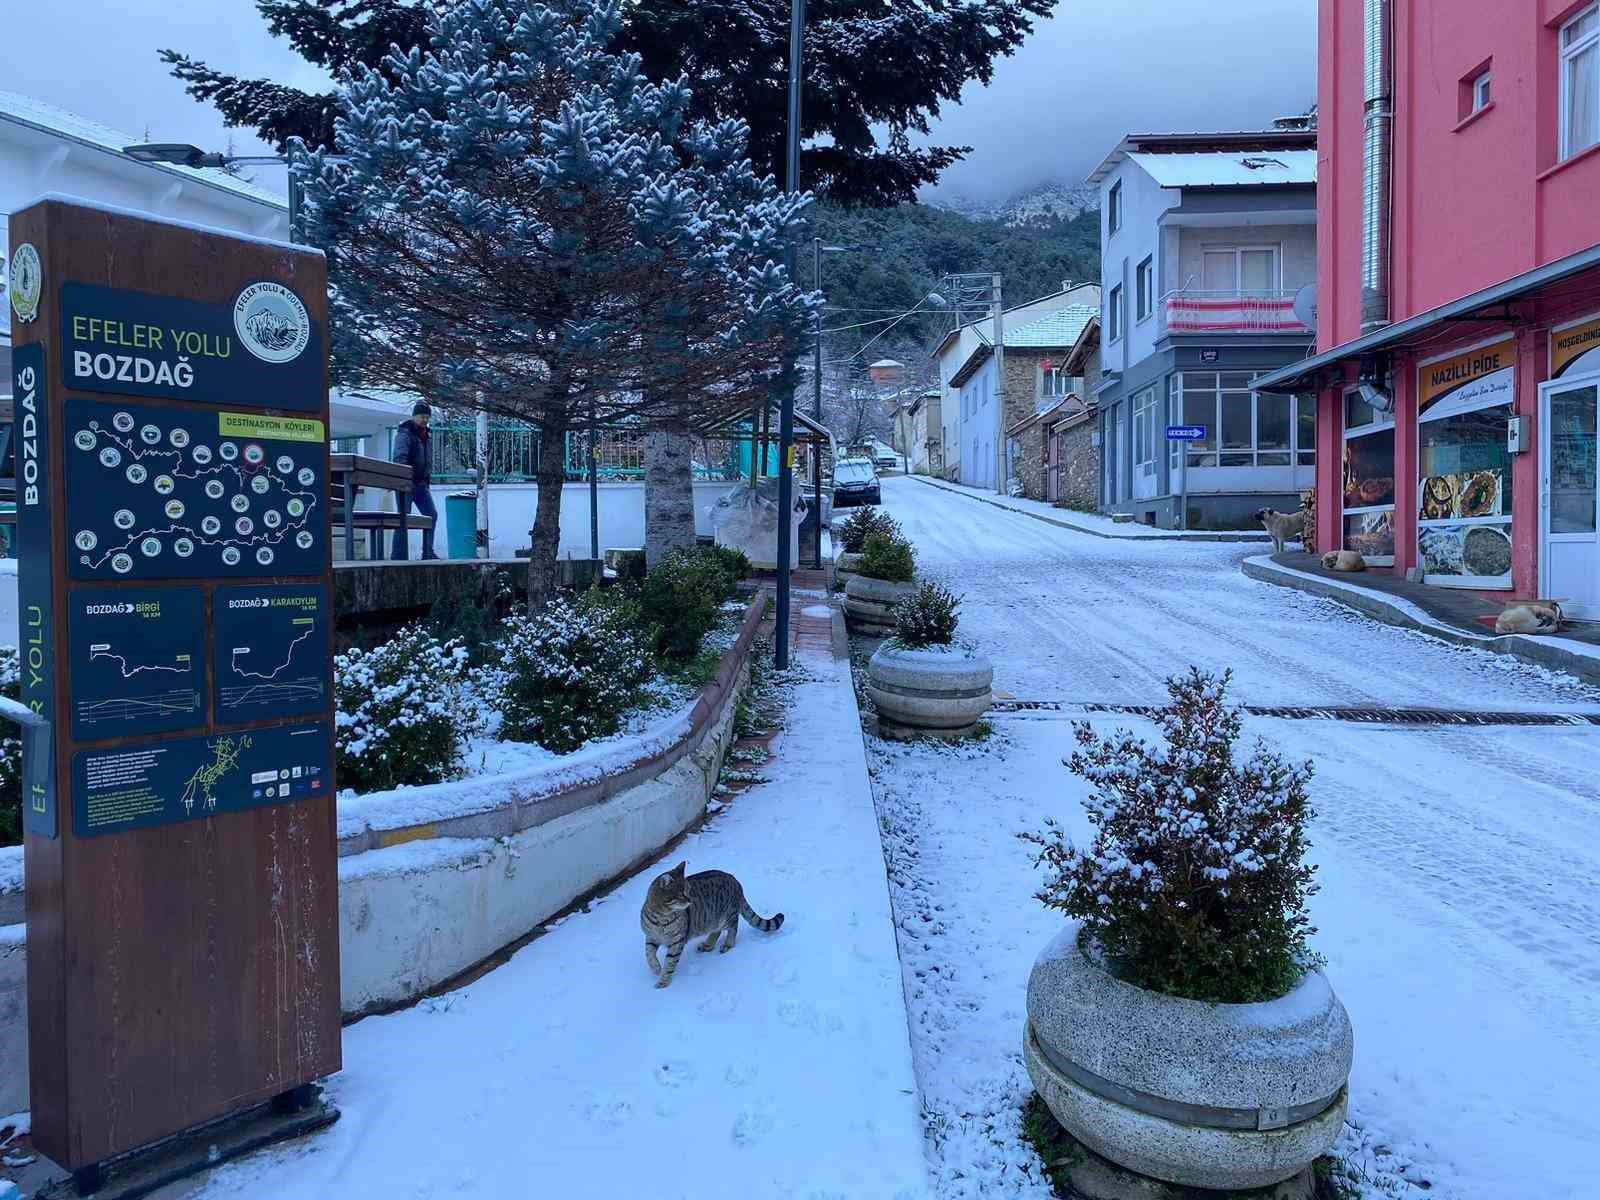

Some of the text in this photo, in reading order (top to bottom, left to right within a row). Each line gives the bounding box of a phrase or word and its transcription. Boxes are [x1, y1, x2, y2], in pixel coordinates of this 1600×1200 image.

[236, 287, 257, 312] EFELER
[72, 315, 231, 358] EFELER YOLU
[73, 349, 194, 388] BOZDAĞ
[1431, 353, 1500, 387] NAZİLLİ PİDE
[17, 366, 39, 505] BOZDAĞ
[226, 417, 315, 433] DESTİNASYON KÖYLERİ
[86, 601, 160, 615] BOZDAĞ BİRGİ
[229, 597, 261, 609] BOZDAĞ
[27, 606, 44, 687] YOLU
